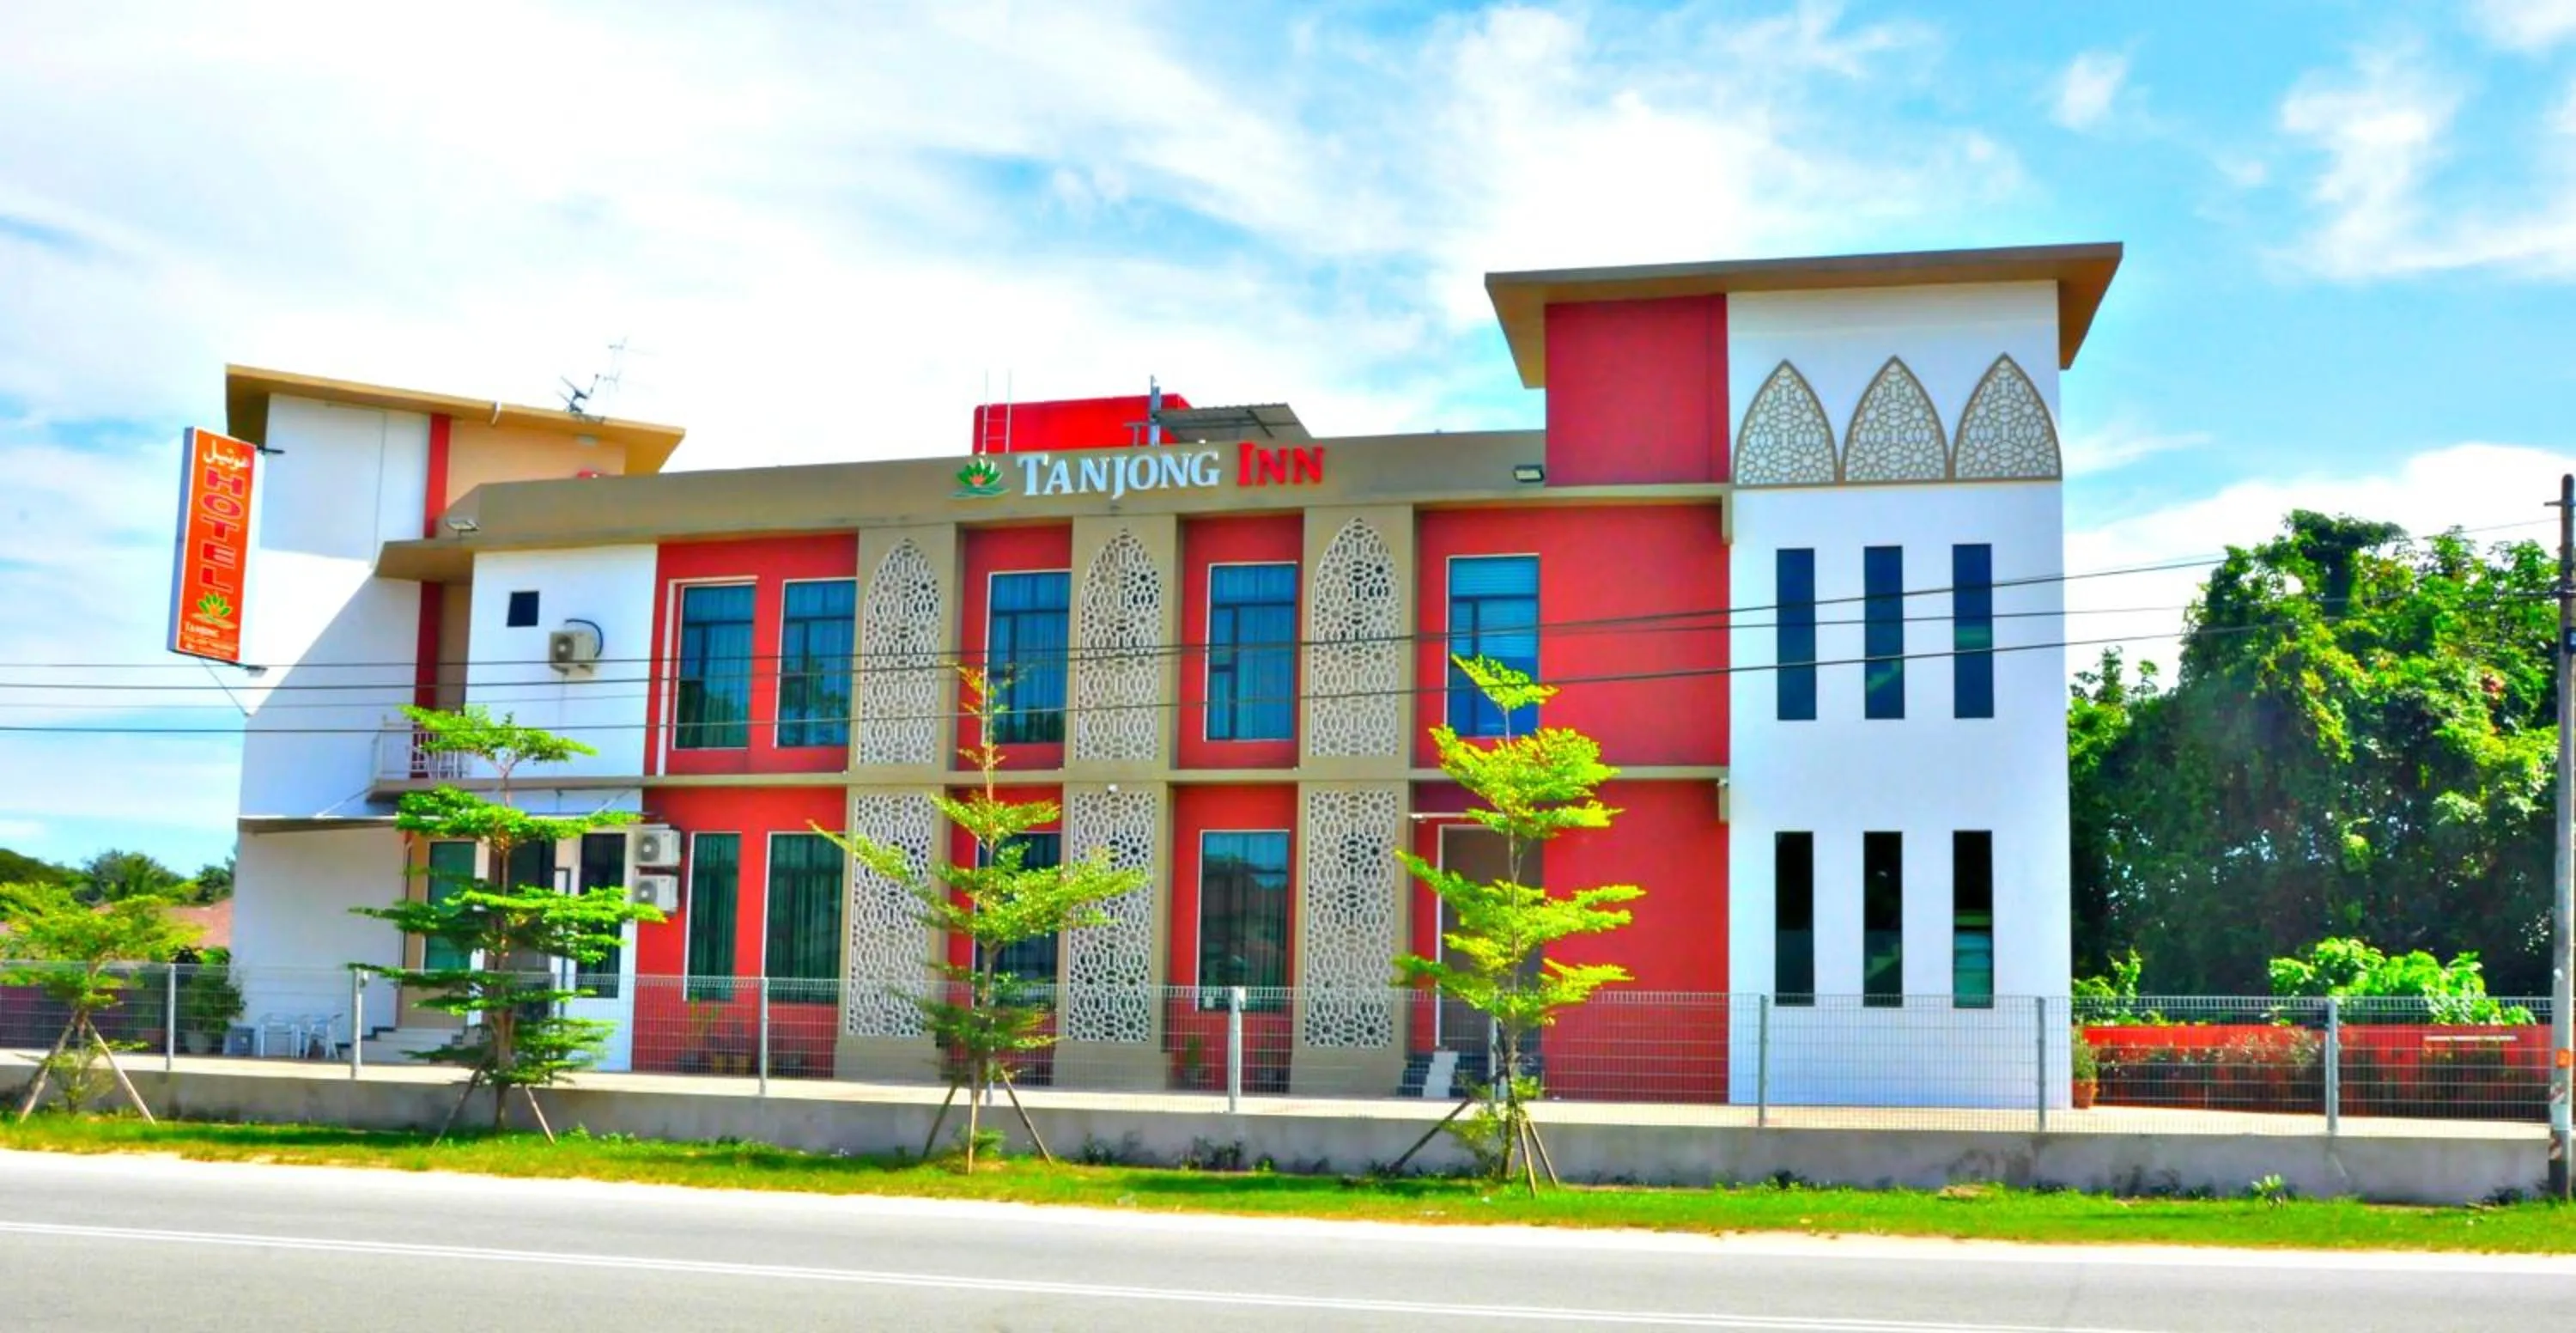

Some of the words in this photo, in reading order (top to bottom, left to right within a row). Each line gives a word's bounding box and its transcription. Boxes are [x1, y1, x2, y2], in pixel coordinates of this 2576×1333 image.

[1017, 449, 1221, 500] TANJONG
[1236, 441, 1325, 487] INN
[198, 466, 246, 593] HOTEL
